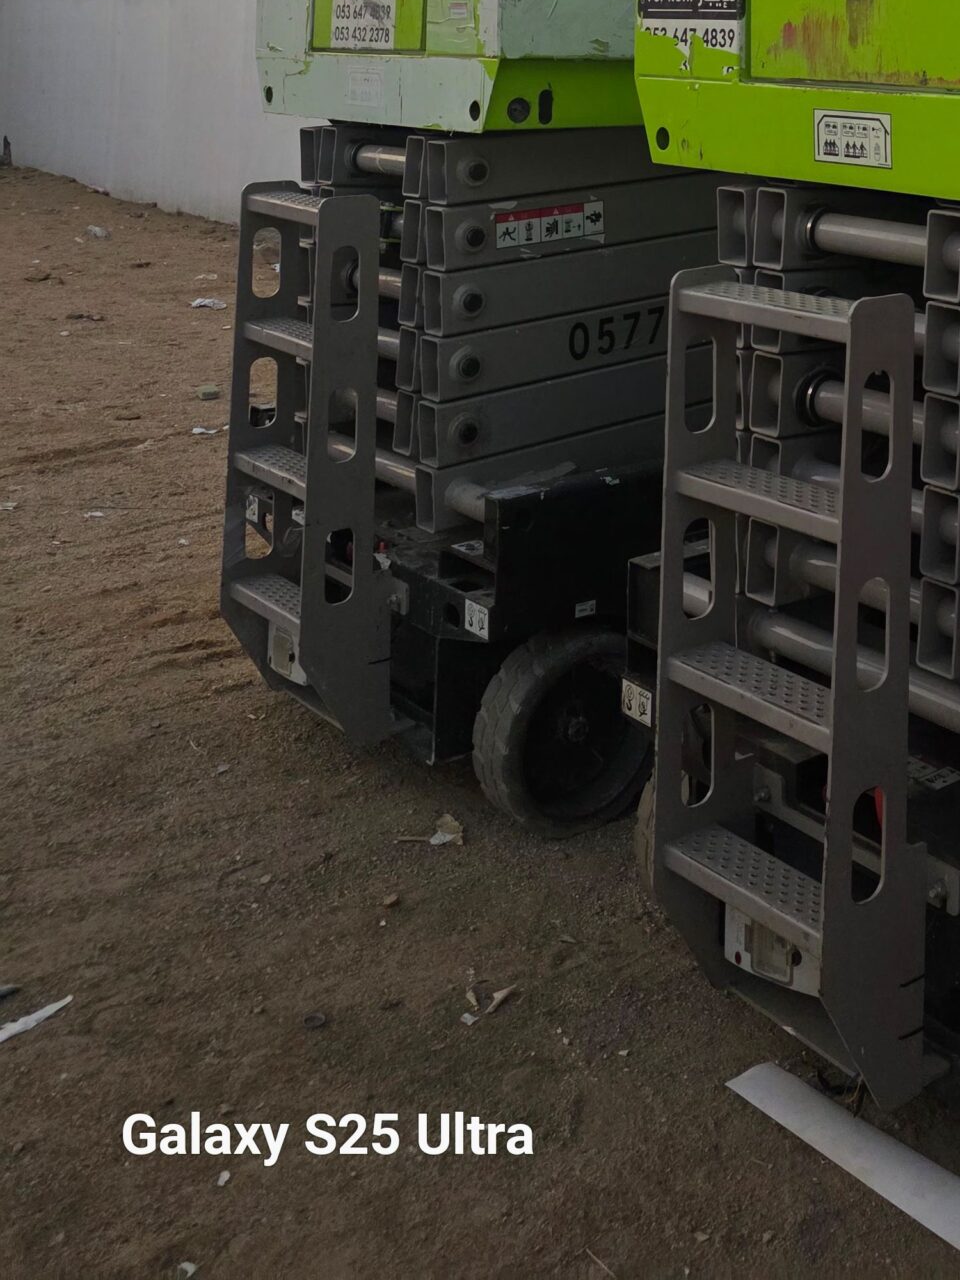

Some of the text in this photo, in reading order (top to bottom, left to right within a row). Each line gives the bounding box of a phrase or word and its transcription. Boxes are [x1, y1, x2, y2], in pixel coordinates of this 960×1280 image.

[335, 4, 351, 20] 053
[353, 4, 368, 20] 647
[334, 26, 390, 43] 053 432 2378
[703, 27, 736, 48] 4839
[568, 305, 665, 361] 0577
